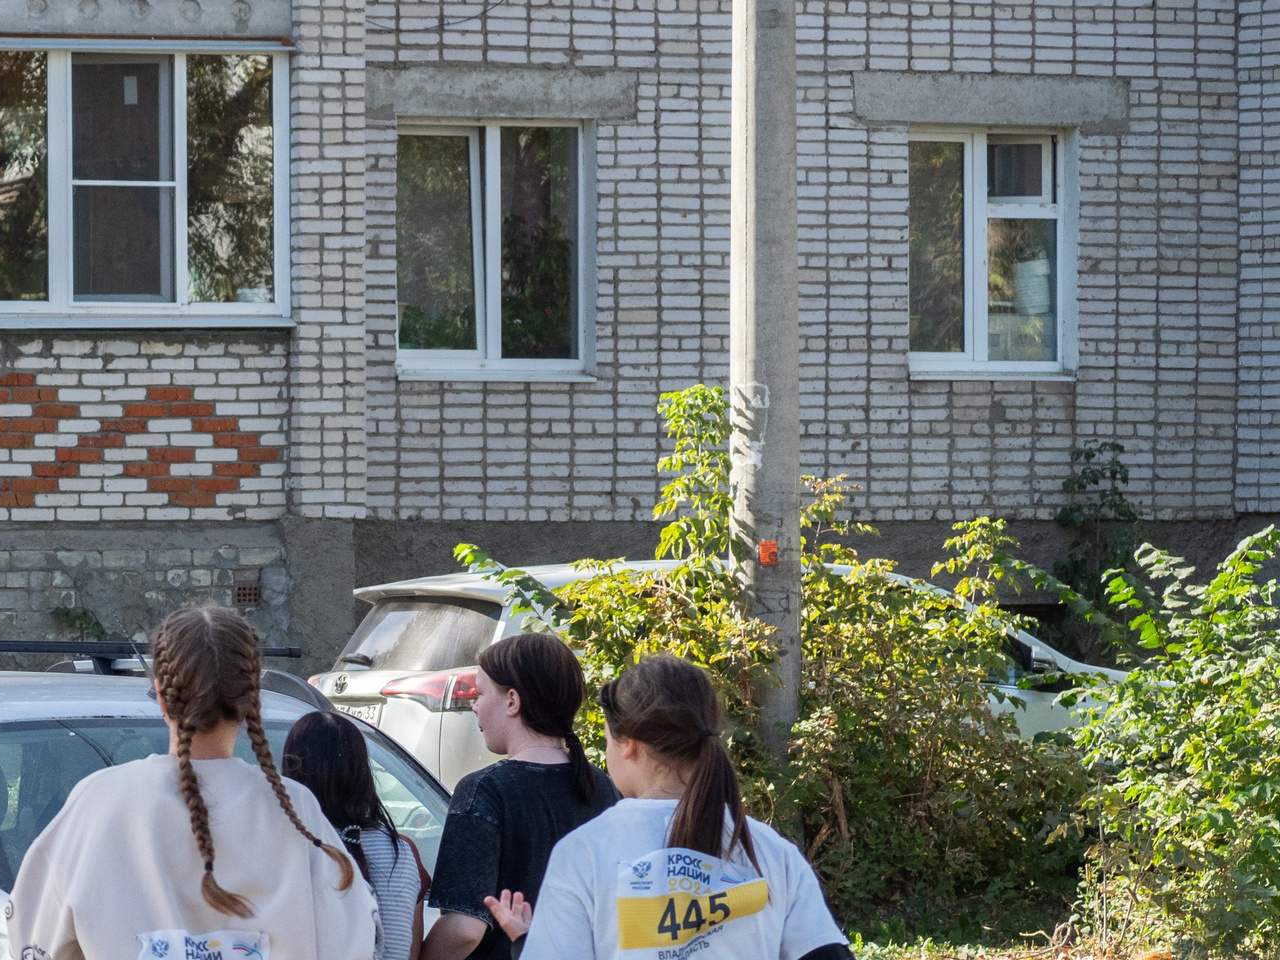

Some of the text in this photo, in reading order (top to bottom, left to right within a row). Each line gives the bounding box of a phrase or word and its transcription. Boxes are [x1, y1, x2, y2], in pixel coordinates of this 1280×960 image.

[667, 854, 702, 870] КРОСС
[667, 866, 711, 885] НАЦИИ
[657, 892, 731, 941] 445
